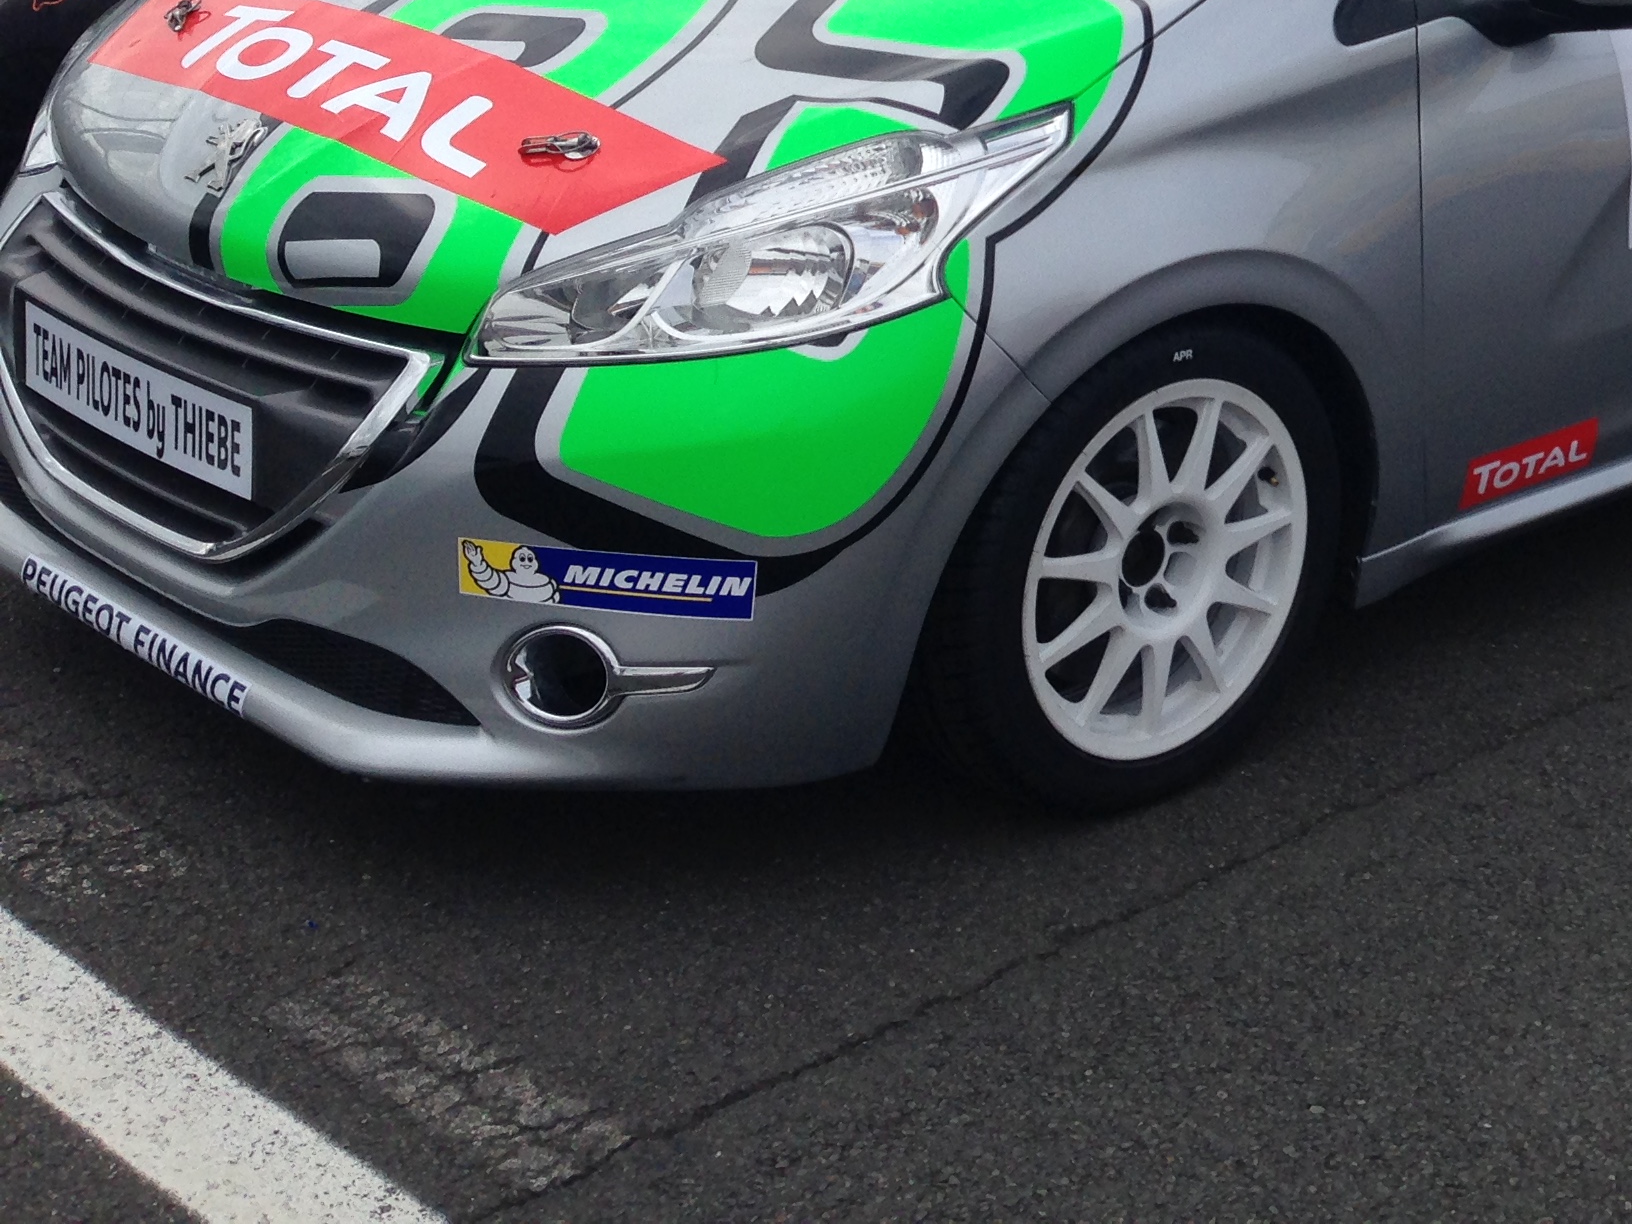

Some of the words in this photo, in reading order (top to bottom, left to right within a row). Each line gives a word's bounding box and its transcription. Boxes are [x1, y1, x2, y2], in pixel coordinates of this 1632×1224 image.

[181, 3, 495, 178] TOTAL
[33, 322, 72, 383] TEAM
[74, 346, 142, 433] PILOTES
[145, 382, 167, 462] by
[169, 391, 242, 478] THIEBE
[1473, 439, 1587, 496] TOTAL
[21, 557, 132, 652] PEUGEOT
[132, 622, 246, 714] FINANCE
[563, 563, 753, 601] MICHELIN
